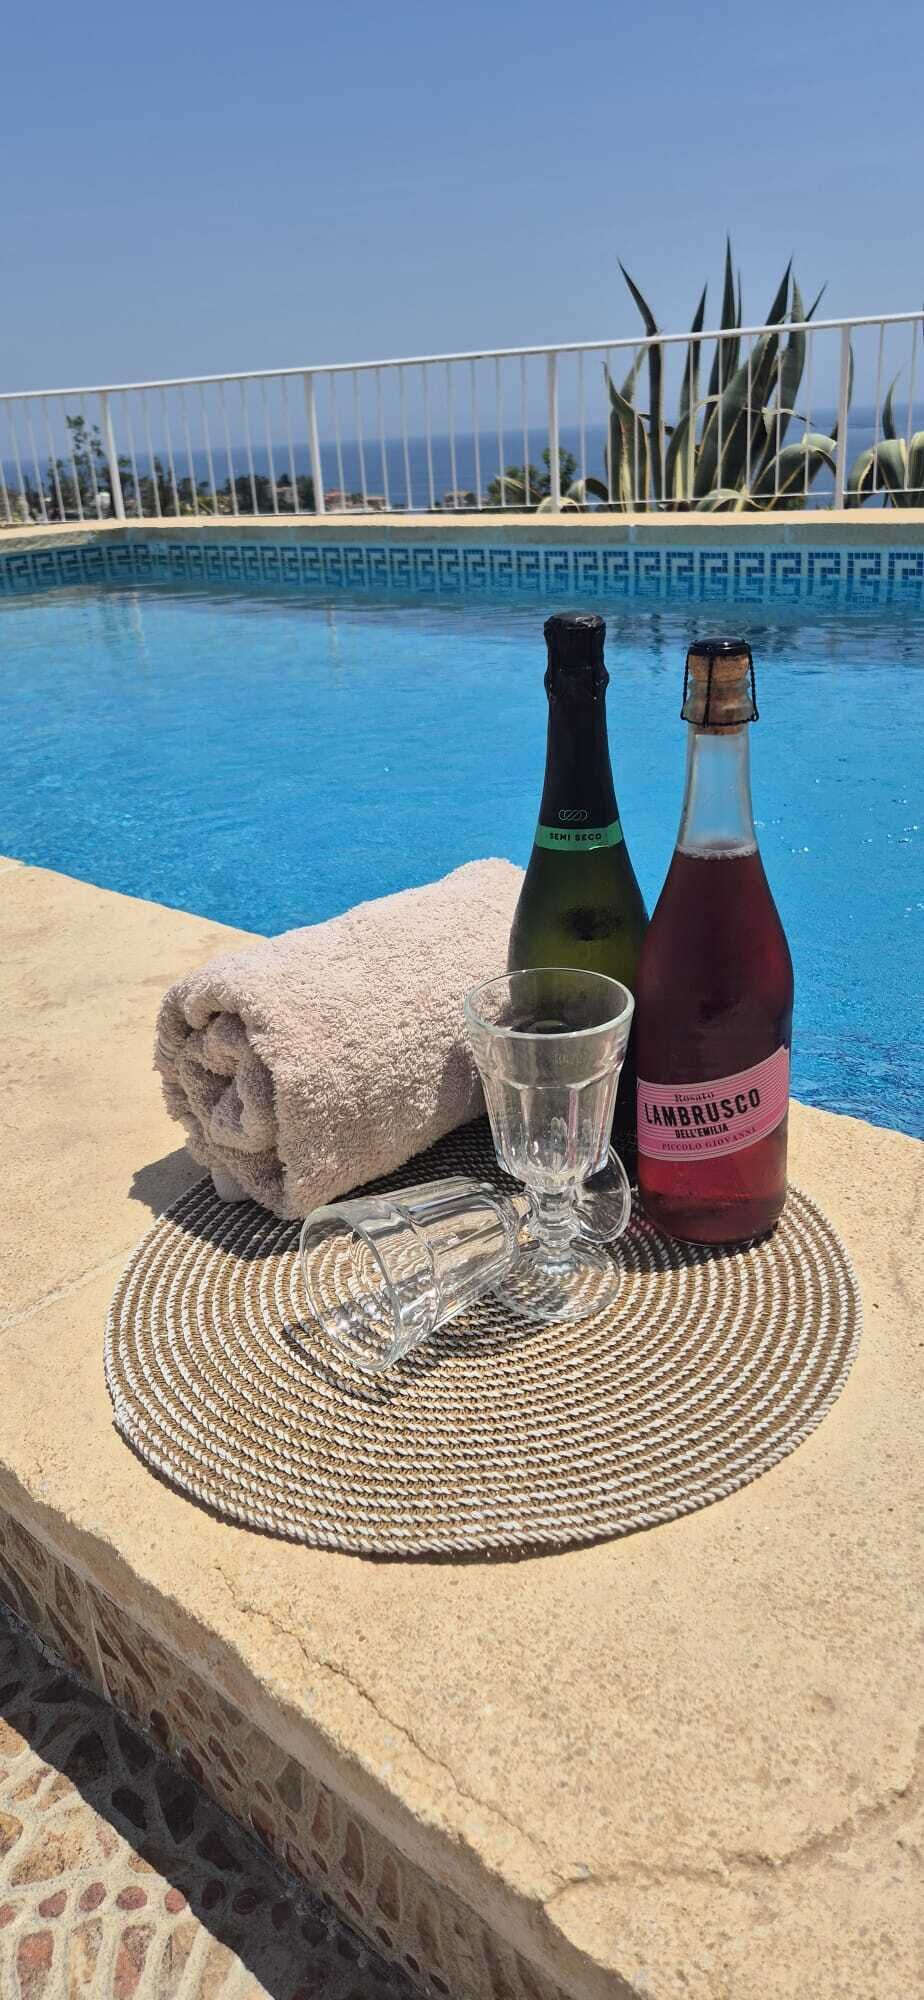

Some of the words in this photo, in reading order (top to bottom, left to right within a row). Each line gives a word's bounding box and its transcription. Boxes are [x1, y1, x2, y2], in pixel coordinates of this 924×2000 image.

[549, 832, 571, 841] SEMI
[575, 832, 602, 841] SECO
[674, 1092, 715, 1103] Rosato
[644, 1088, 761, 1126] LAMBRUSCO
[662, 1142, 702, 1151] PICCOLO
[705, 1127, 756, 1149] GIOVANNI
[675, 1124, 729, 1139] DELL'EMILIA
